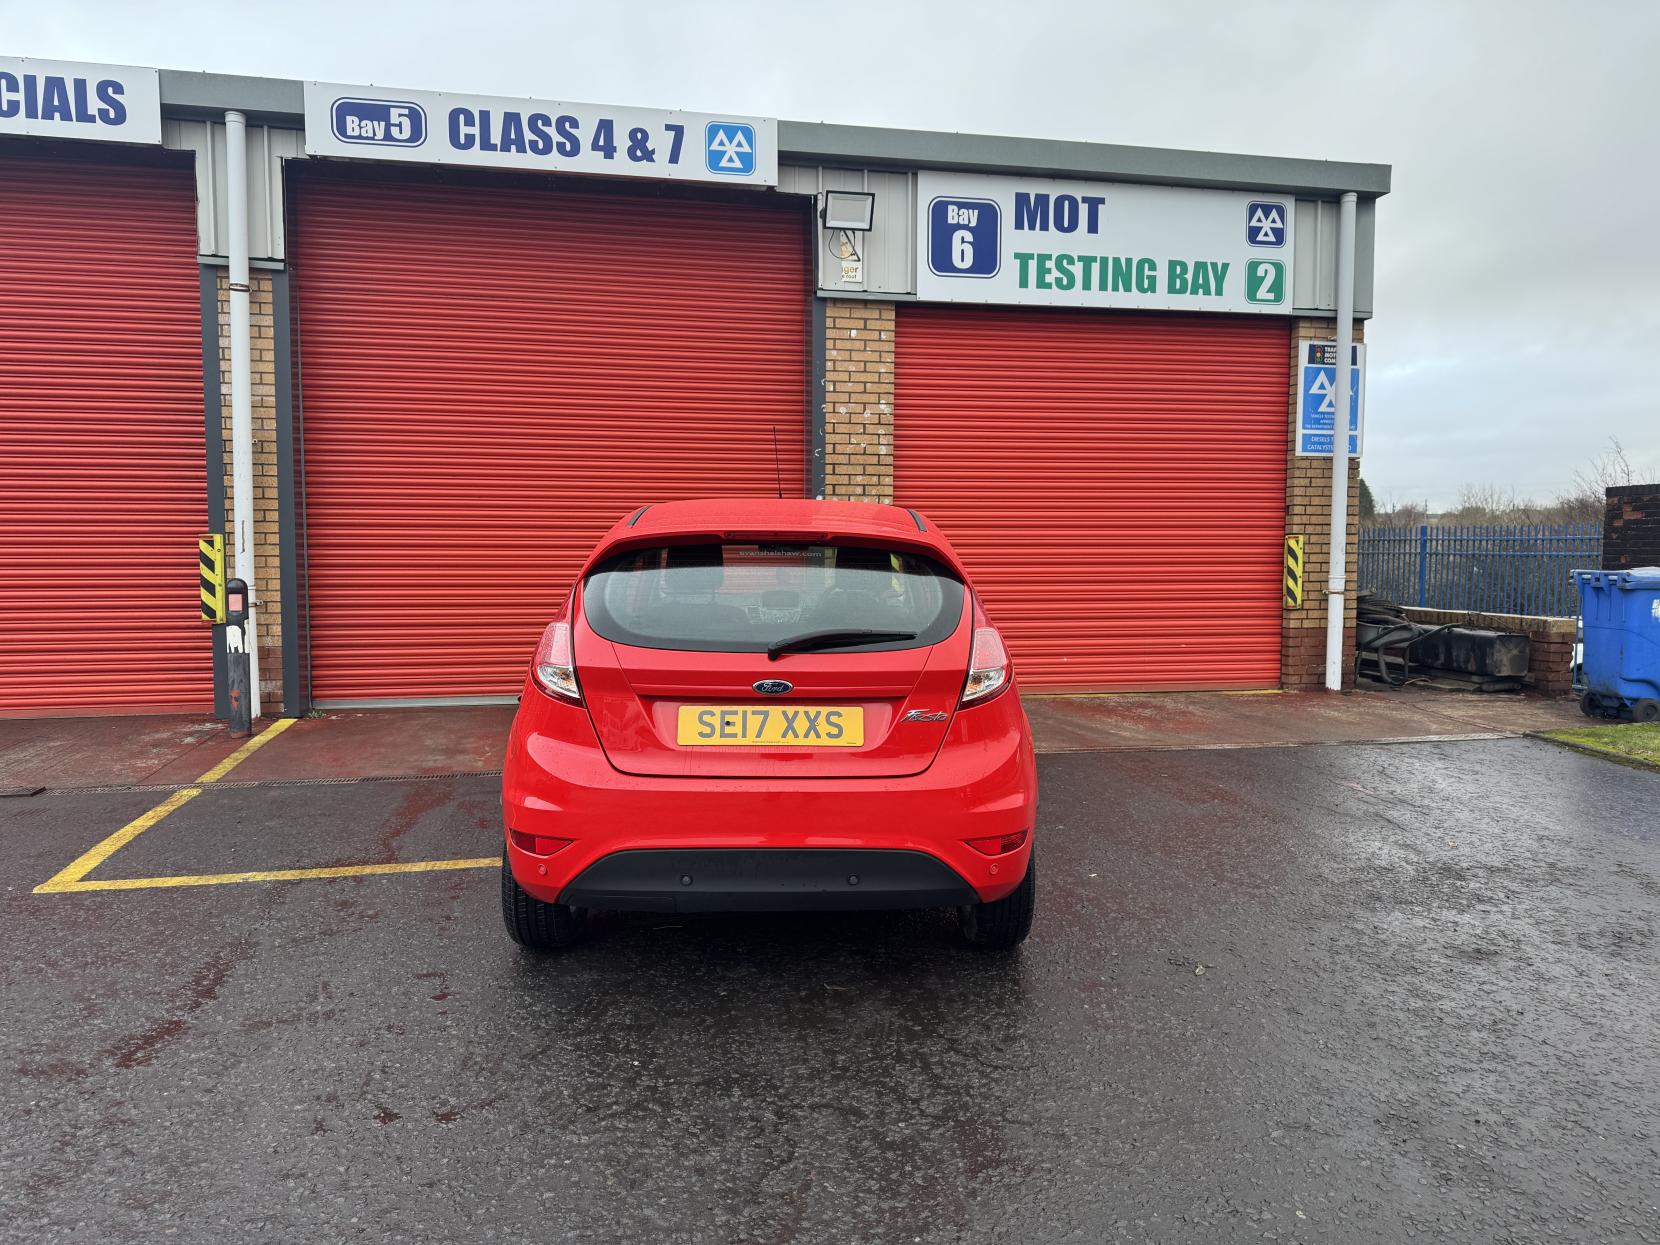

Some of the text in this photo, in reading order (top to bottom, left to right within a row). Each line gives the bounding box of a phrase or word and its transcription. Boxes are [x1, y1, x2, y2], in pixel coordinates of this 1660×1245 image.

[0, 71, 127, 126] CIALS
[345, 107, 412, 140] Bay 5
[448, 107, 685, 164] CLASS 4 & 7
[947, 204, 979, 227] Bay
[1014, 191, 1106, 235] MOT
[951, 229, 974, 269] 6
[842, 266, 859, 275] ger
[1013, 252, 1231, 297] TESTING BAY
[1256, 262, 1276, 300] 2
[761, 681, 785, 693] Ford
[697, 709, 844, 740] SE17 XXS
